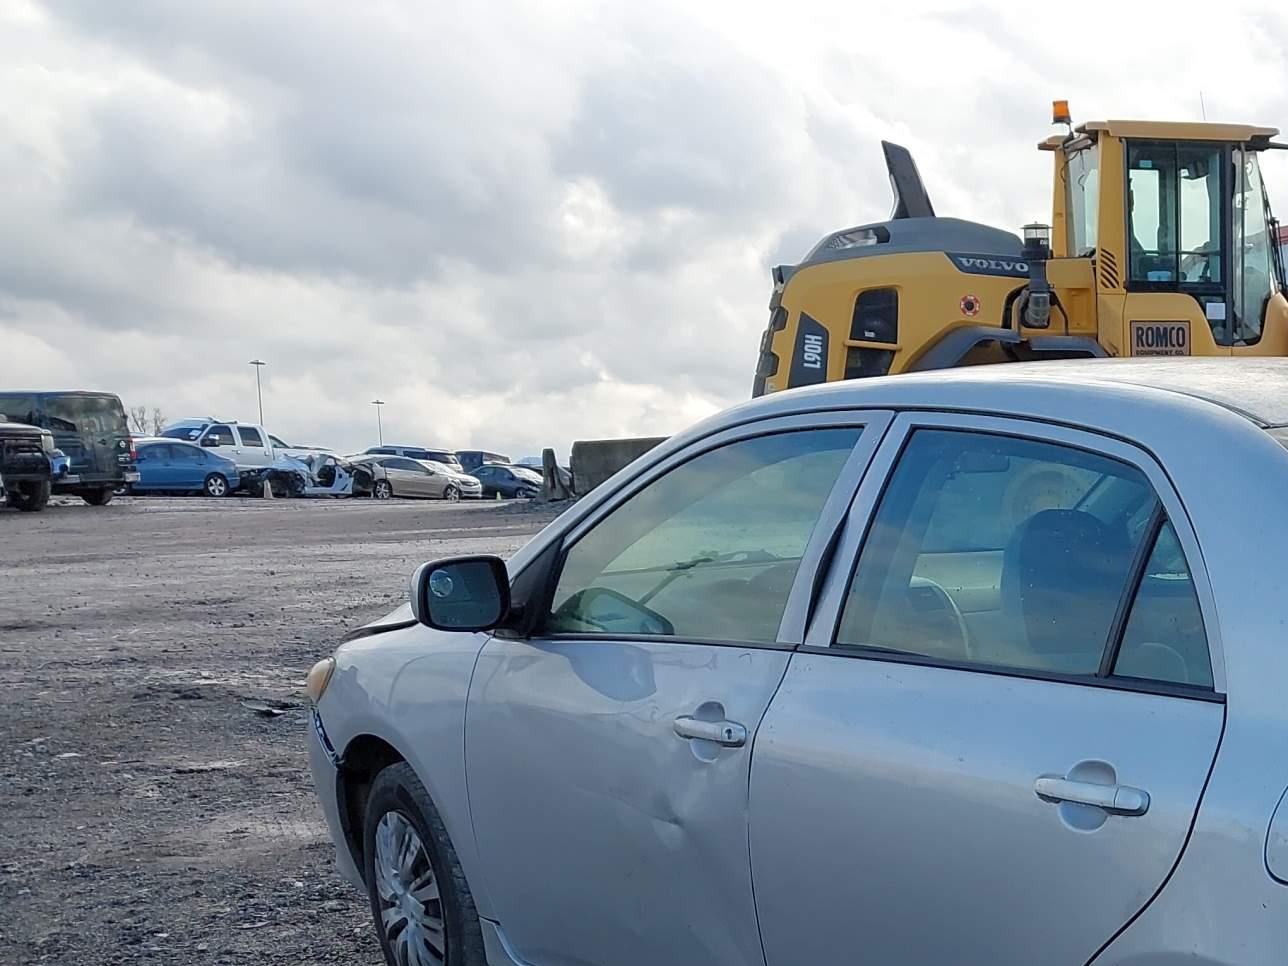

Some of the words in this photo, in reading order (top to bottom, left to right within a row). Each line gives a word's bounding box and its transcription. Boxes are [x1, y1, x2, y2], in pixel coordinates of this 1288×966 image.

[958, 257, 1029, 272] VOLVO
[1135, 326, 1186, 348] ROMCO
[803, 334, 823, 369] L90H
